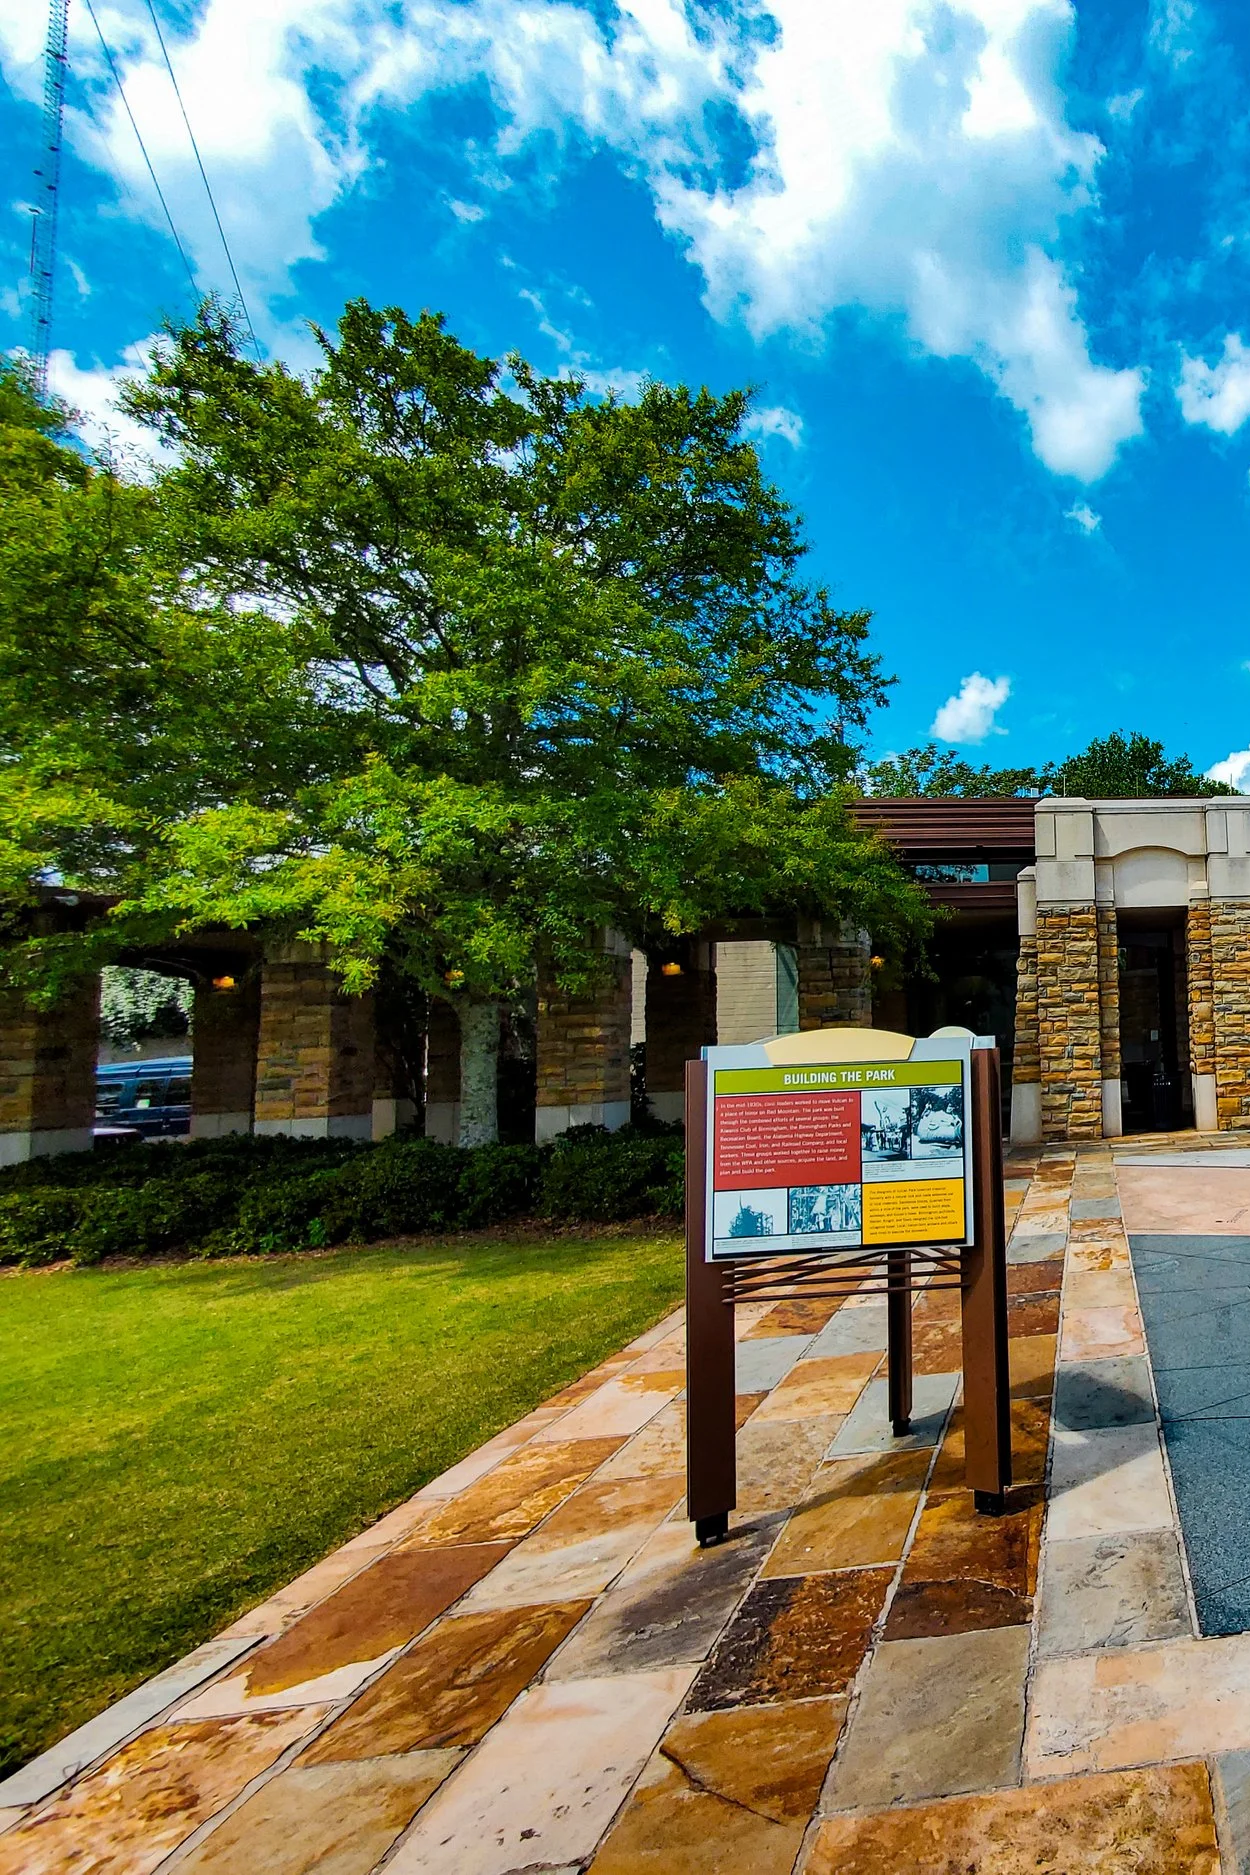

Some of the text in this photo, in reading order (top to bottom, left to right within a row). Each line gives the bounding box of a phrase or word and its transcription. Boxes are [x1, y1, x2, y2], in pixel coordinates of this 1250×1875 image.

[784, 1069, 895, 1085] BUILDING THE PARK
